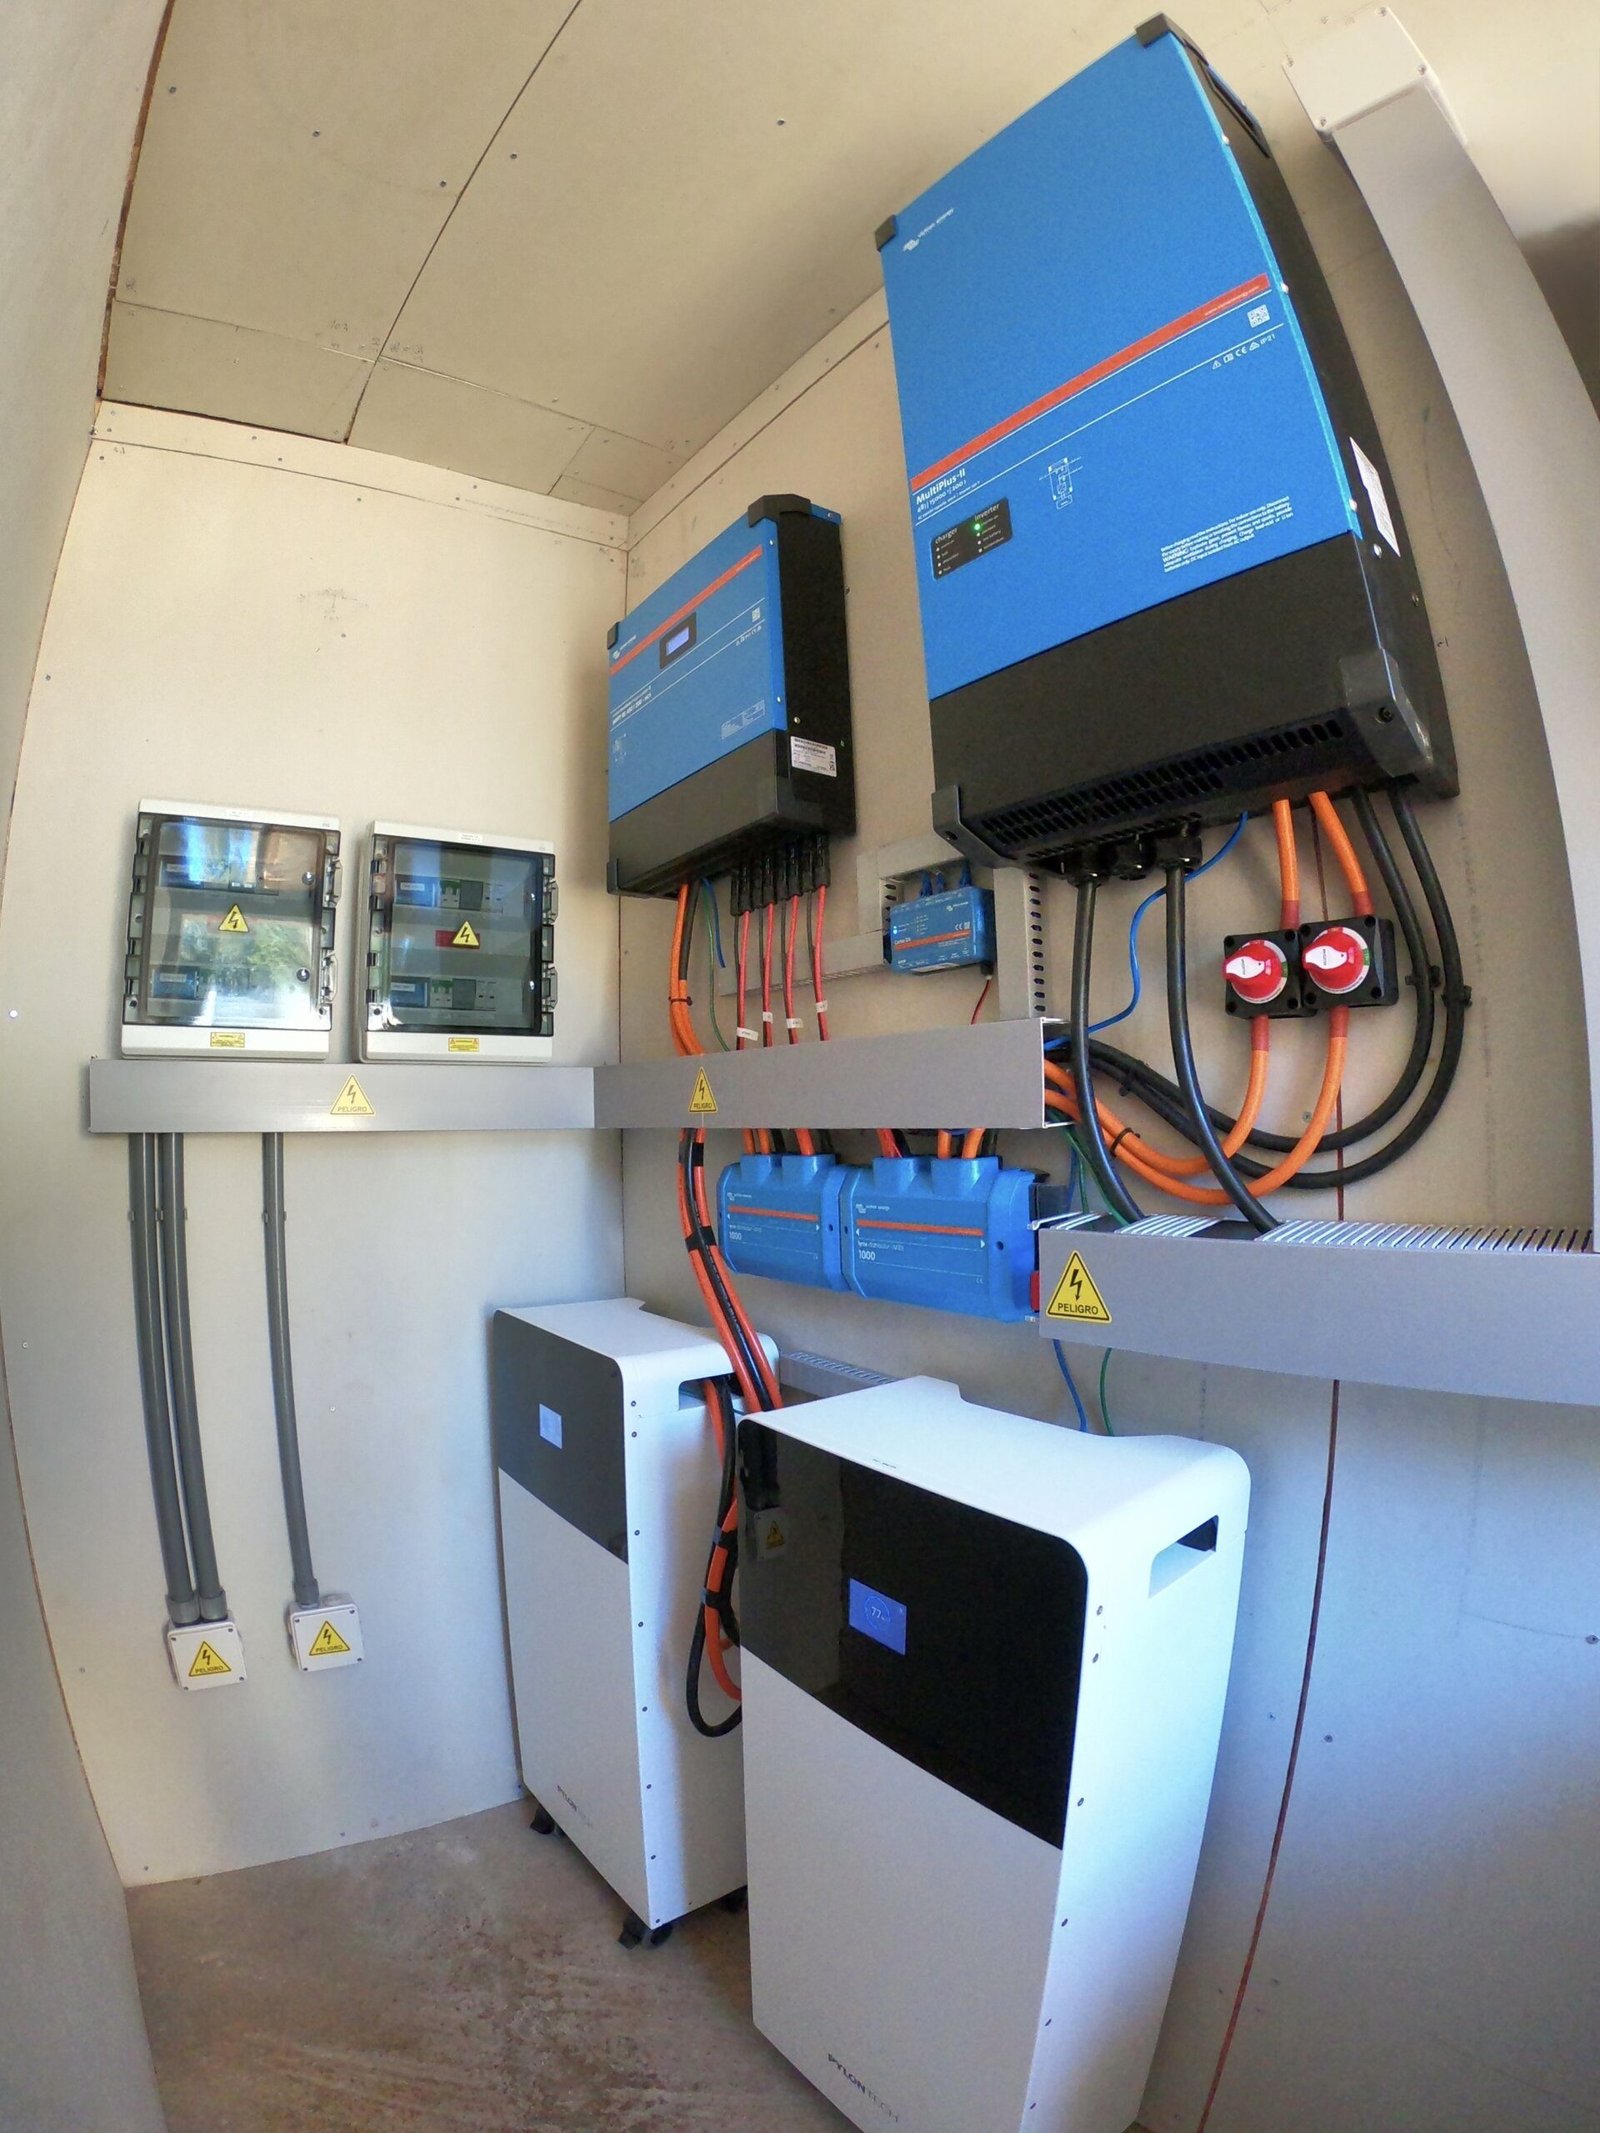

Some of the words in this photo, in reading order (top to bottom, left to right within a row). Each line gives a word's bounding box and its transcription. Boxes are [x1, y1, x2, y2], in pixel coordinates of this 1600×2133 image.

[916, 468, 966, 504] MultiPlus-II
[975, 504, 999, 521] inverter
[935, 527, 958, 544] charger
[859, 1250, 875, 1260] 1000
[1057, 1302, 1099, 1315] PELIGRO
[315, 1644, 343, 1653] PELIGRO
[195, 1665, 224, 1674] PELIGRO
